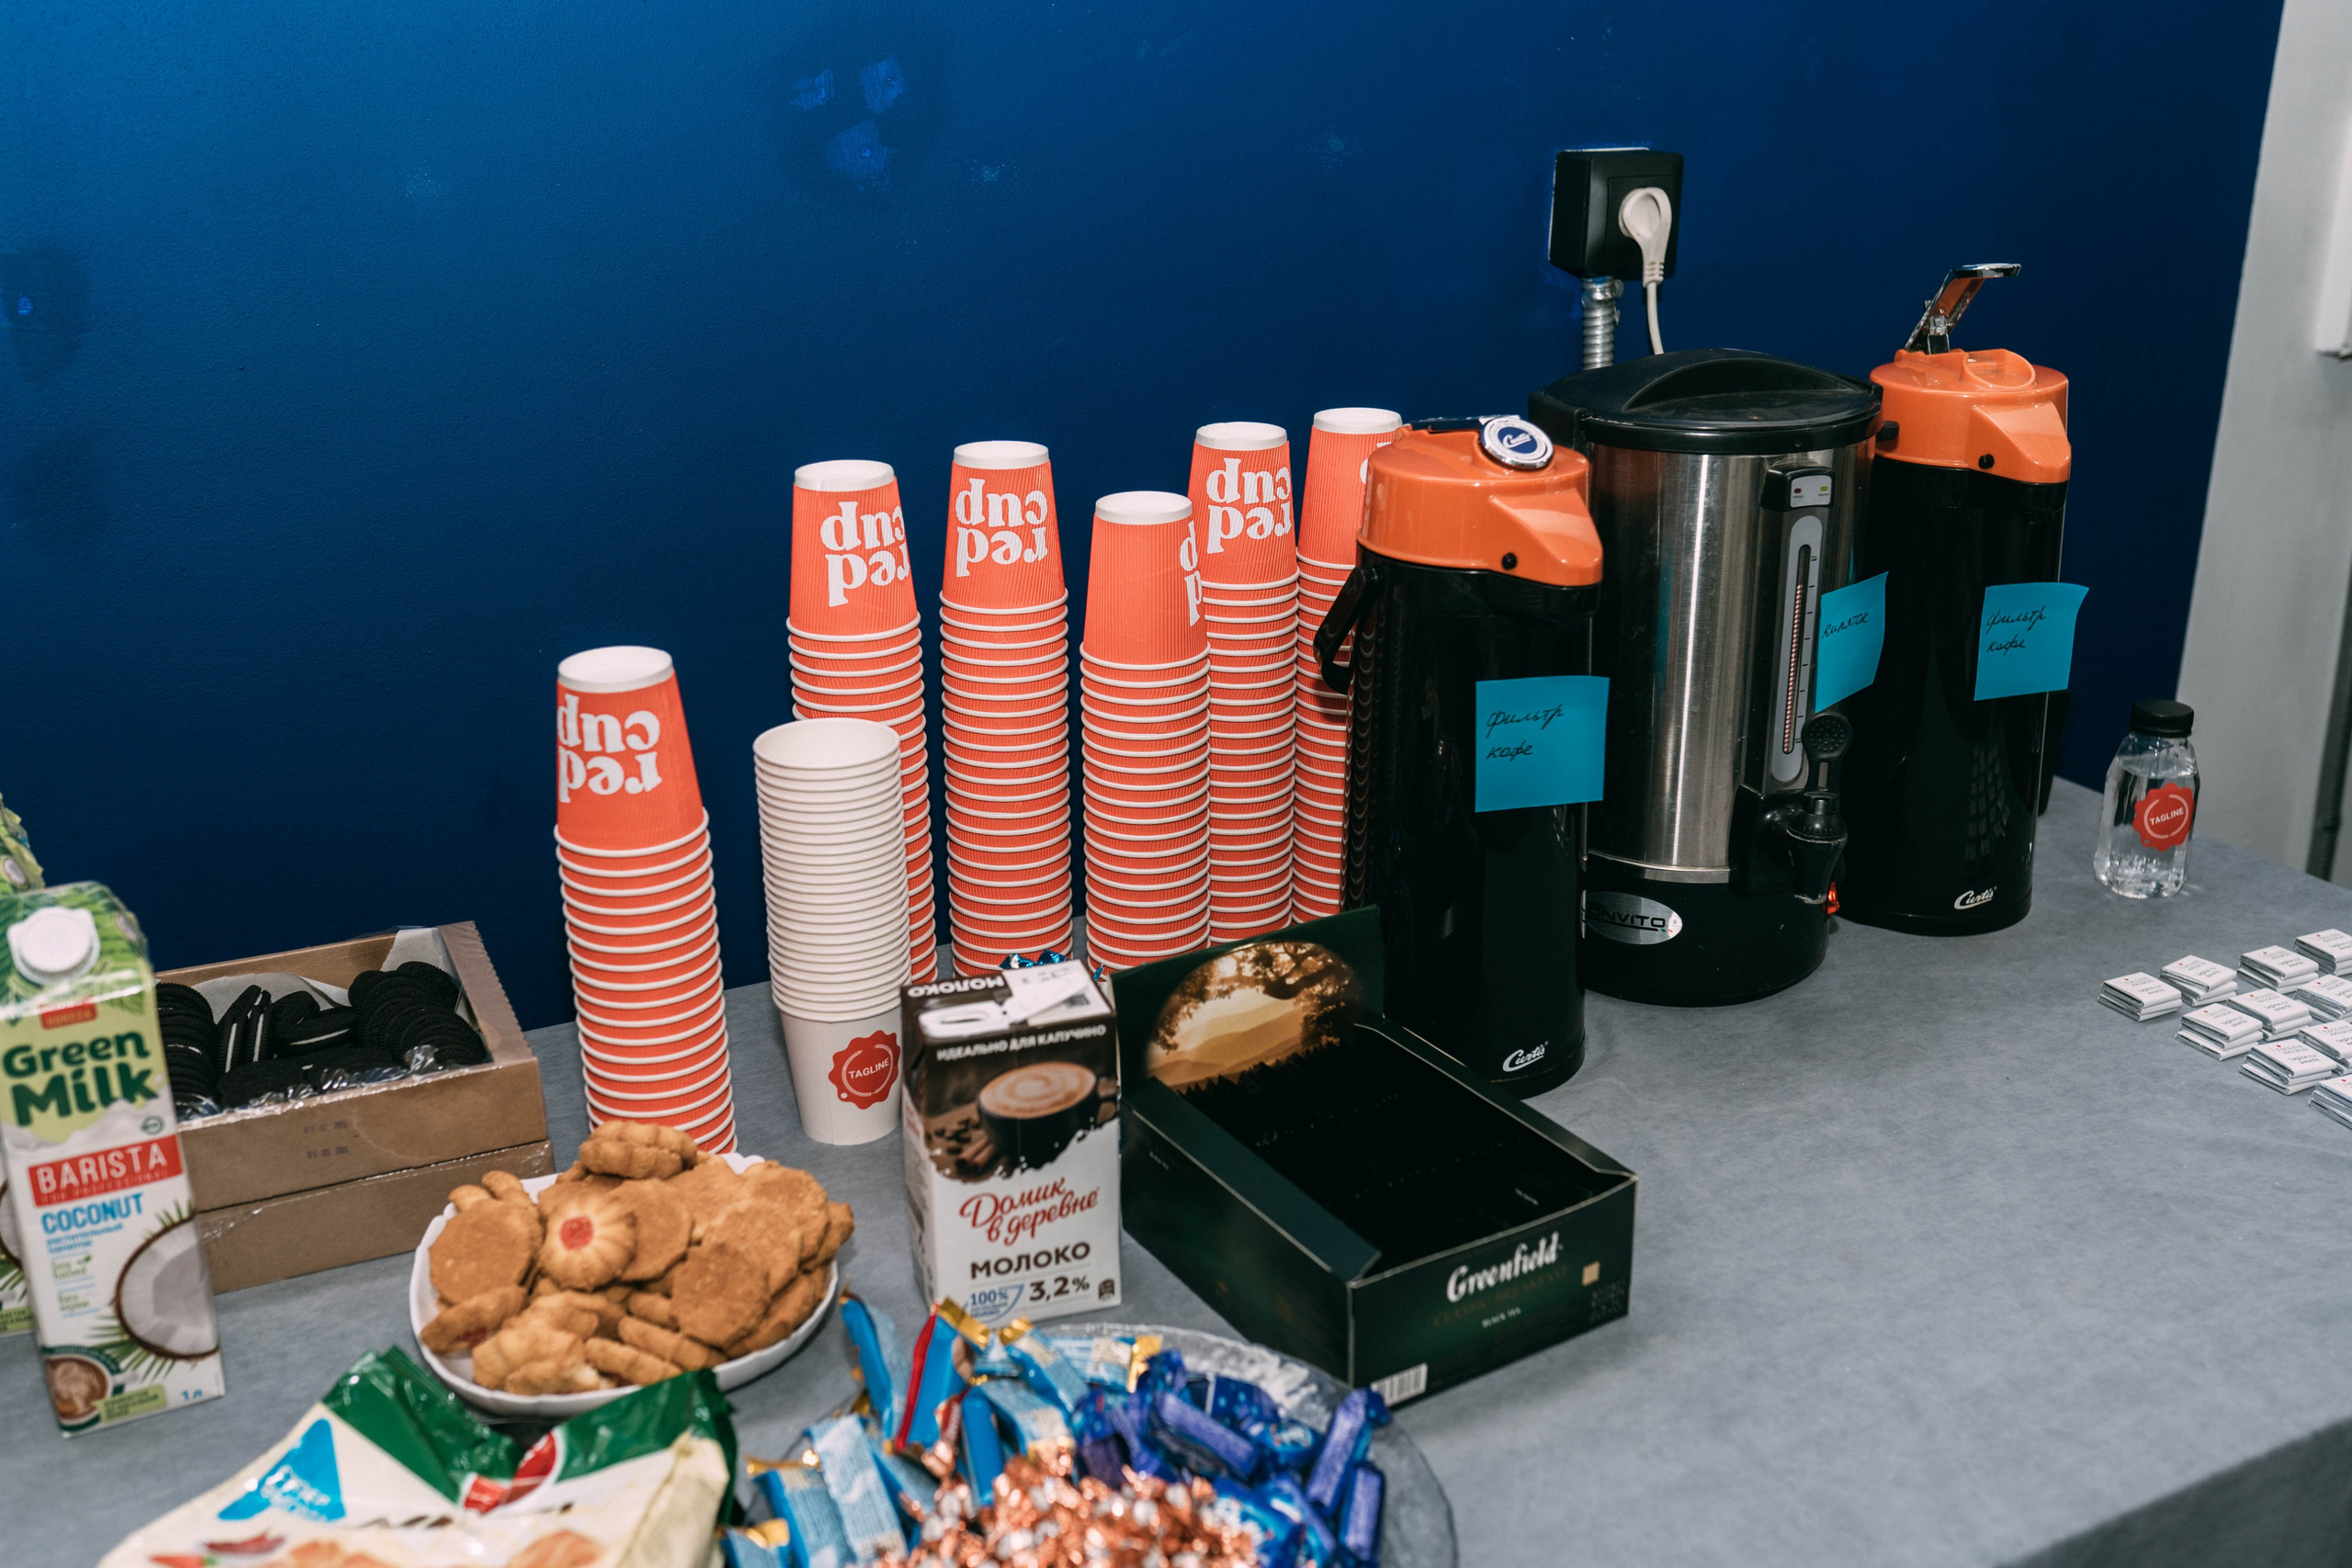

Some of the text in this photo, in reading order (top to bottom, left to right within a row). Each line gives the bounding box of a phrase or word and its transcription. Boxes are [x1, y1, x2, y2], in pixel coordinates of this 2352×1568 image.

[955, 477, 1048, 526] cup
[1205, 457, 1291, 504] cup
[820, 501, 906, 551] cup
[1207, 501, 1293, 554] red
[956, 526, 1048, 578] red
[824, 546, 910, 607] red
[557, 694, 661, 754] cup
[1486, 703, 1564, 738] фильтр
[1486, 739, 1533, 760] кофе
[559, 745, 662, 803] red
[2149, 806, 2185, 826] TAGLINE
[1581, 903, 1666, 929] ONVITO
[1954, 888, 1993, 909] Curtis
[907, 976, 1006, 998] МОЛОКО
[3, 1030, 151, 1078] Green
[936, 1024, 1106, 1061] ИДЕАЛЬНО ДЛЯ КАПУЧИНО
[1502, 1043, 1545, 1073] Curtis
[848, 1057, 890, 1079] TAGLINE
[11, 1061, 159, 1128] Milk
[35, 1143, 168, 1195] BARISTA
[41, 1193, 143, 1235] COCONUT
[959, 1178, 1066, 1229] Домик
[987, 1188, 1100, 1246] в деревне
[970, 1241, 1091, 1280] МОЛОКО
[1446, 1231, 1559, 1303] Greenfield
[970, 1289, 1009, 1306] 100%
[1029, 1275, 1091, 1303] 3,2%
